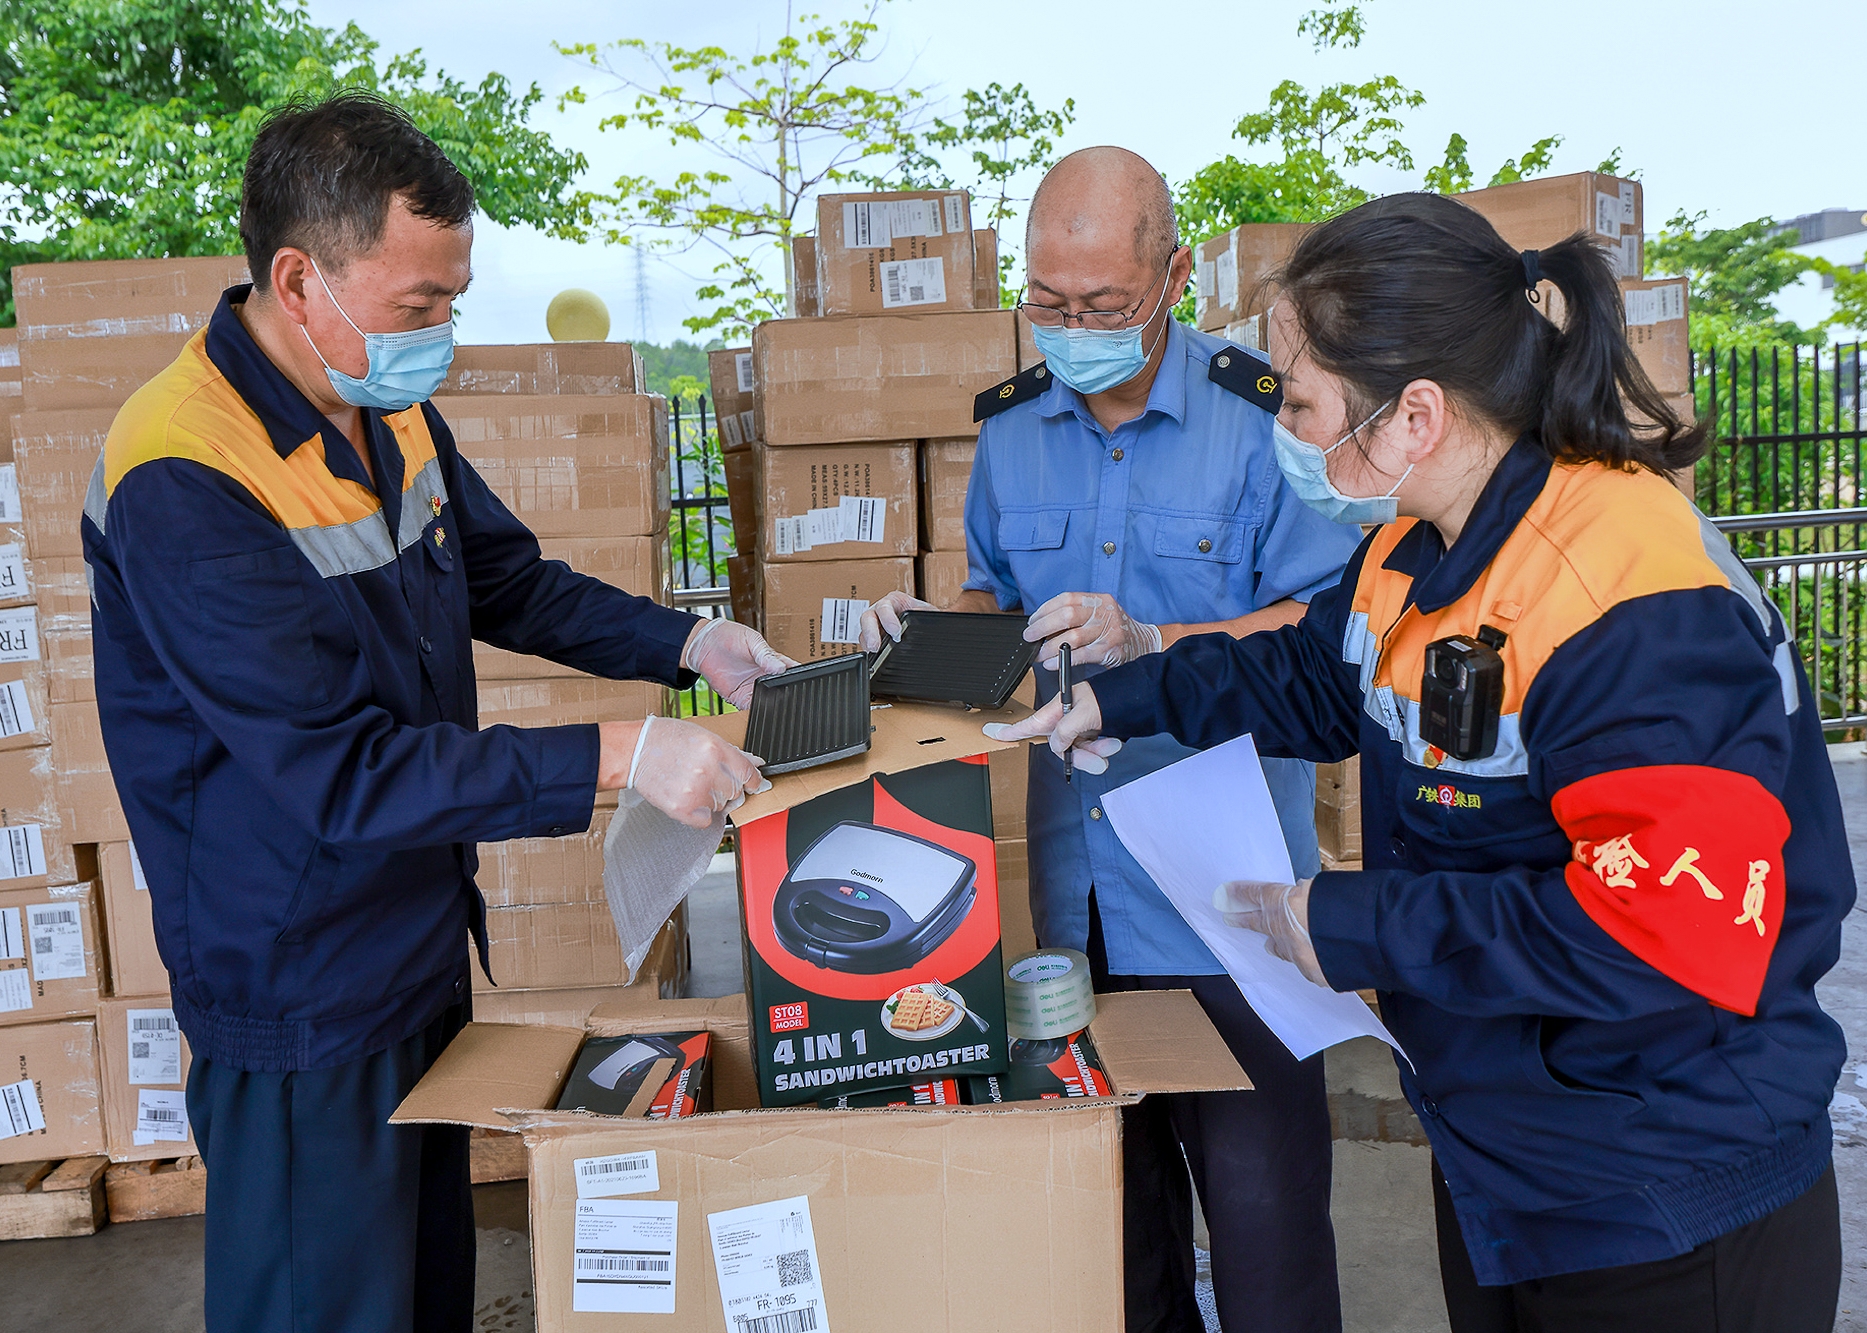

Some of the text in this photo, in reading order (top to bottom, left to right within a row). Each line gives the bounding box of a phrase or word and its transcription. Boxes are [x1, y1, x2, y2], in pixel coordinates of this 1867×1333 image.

[1415, 785, 1481, 809] 广铁集团
[850, 868, 884, 884] Godmorn
[1573, 833, 1771, 937] 检人员
[774, 1005, 803, 1019] ST08
[775, 1019, 803, 1030] MODEL
[773, 1028, 867, 1065] 4 IN 1
[774, 1043, 991, 1092] SANDWICHTOASTER
[914, 1091, 931, 1105] IN
[988, 1076, 1003, 1104] odmorn
[1065, 1083, 1085, 1098] IN
[579, 1205, 594, 1213] FBA
